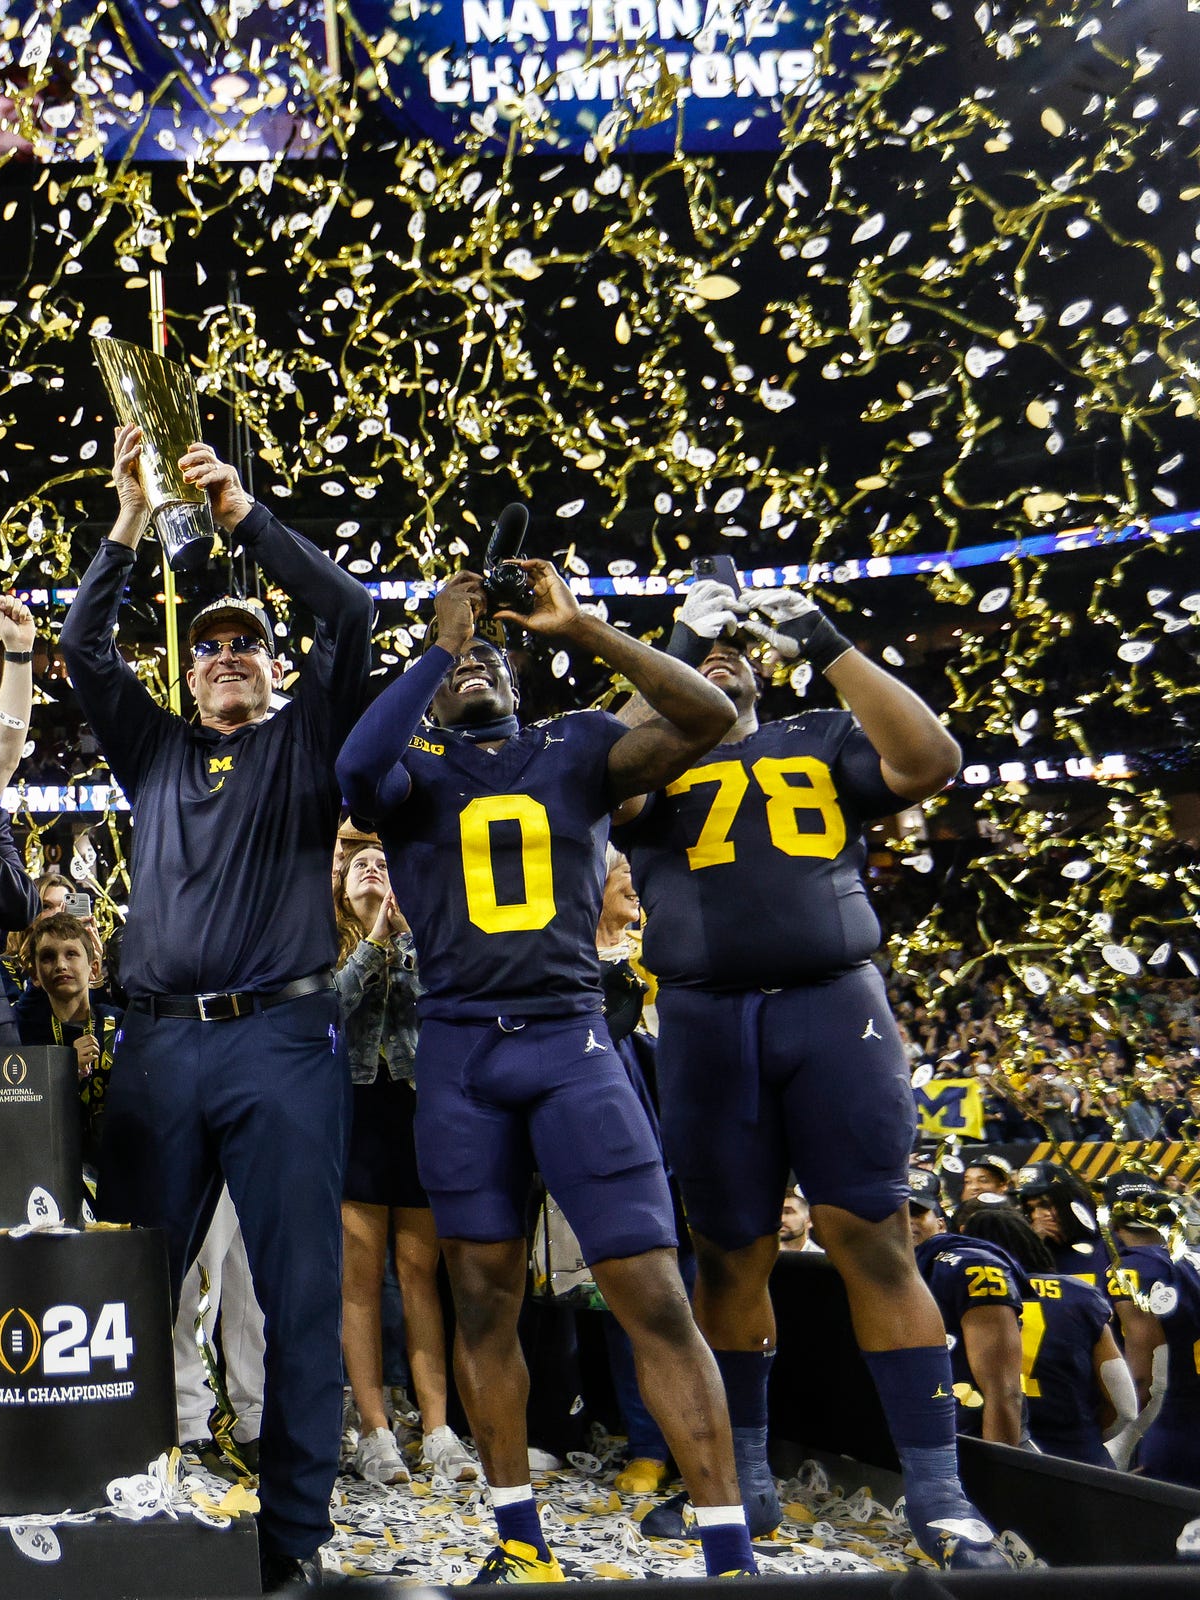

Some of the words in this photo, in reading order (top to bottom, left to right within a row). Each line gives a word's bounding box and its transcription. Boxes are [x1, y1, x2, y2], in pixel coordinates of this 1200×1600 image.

[209, 755, 234, 774] M
[665, 755, 848, 871] 78
[460, 793, 557, 934] 0
[912, 1086, 968, 1128] M
[964, 1265, 1009, 1297] 25
[27, 1381, 136, 1404] CHAMPIONSHIP
